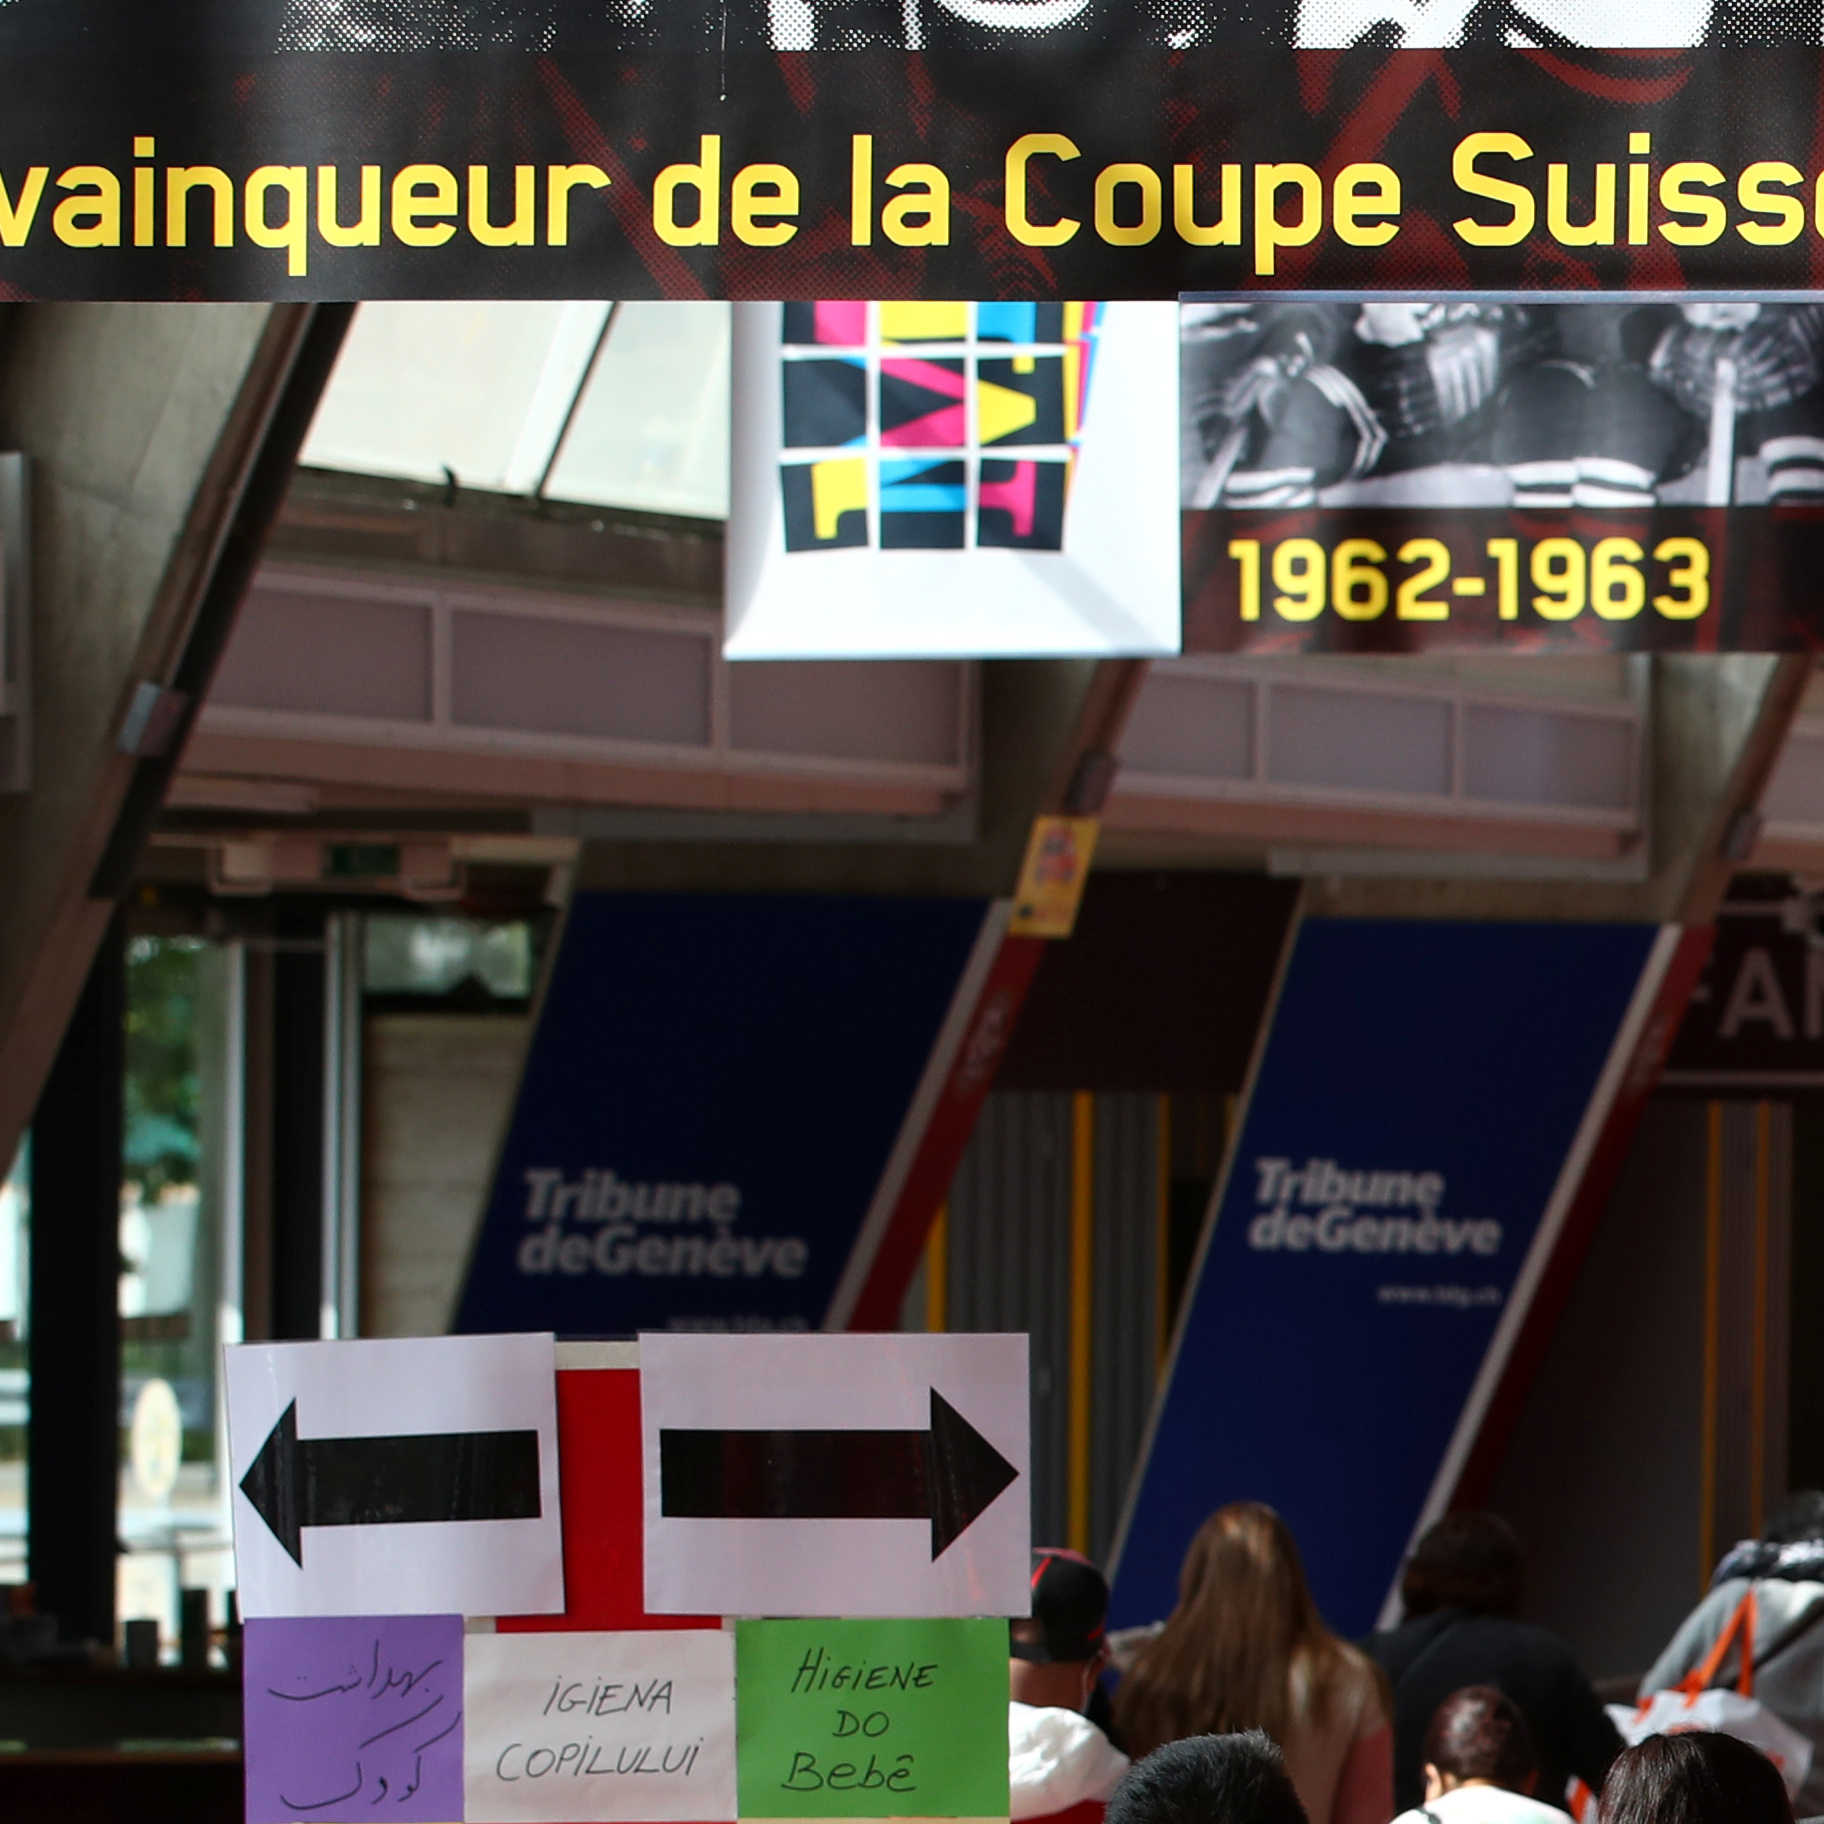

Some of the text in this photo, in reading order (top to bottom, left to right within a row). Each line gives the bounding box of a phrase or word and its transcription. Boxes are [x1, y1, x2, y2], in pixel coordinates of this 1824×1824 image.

[0, 137, 611, 274] vainqueur
[653, 135, 799, 246] de
[852, 135, 949, 246] la
[1006, 134, 1400, 274] Coupe
[1228, 537, 1709, 621] 1962-1963
[522, 1171, 738, 1223] Tribune
[1254, 1159, 1443, 1205] Tribune
[833, 1711, 890, 1739] DO
